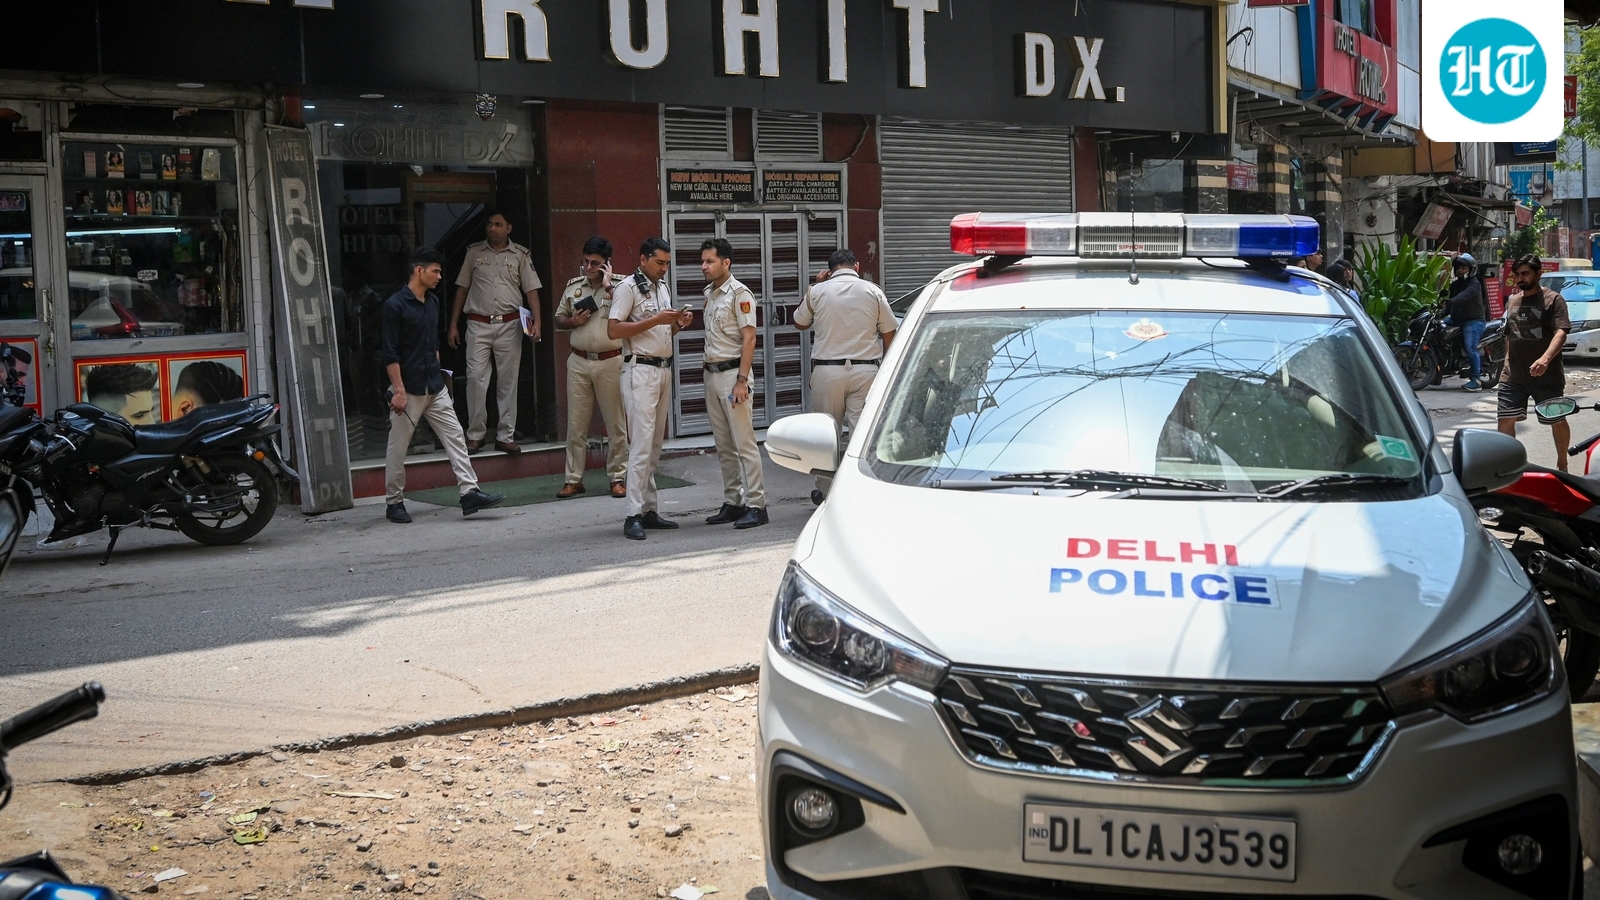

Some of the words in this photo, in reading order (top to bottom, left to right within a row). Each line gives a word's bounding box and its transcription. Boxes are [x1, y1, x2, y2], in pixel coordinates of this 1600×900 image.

[481, 0, 939, 88] ROHIT
[1335, 26, 1357, 57] HOTEL
[275, 142, 306, 161] HOTEL
[321, 123, 452, 160] ROHIT
[463, 130, 517, 163] DX
[670, 183, 682, 191] NEW
[683, 183, 693, 191] SIM
[721, 184, 752, 192] RECHARGES
[671, 172, 690, 182] NEW
[691, 173, 722, 183] MOBILE
[724, 173, 751, 183] PHONE
[765, 173, 793, 181] MOBILE
[794, 173, 819, 181] REPAIR
[820, 173, 839, 181] HERE
[341, 207, 401, 225] OTEL
[319, 481, 343, 500] DX
[1066, 537, 1239, 566] DELHI
[1049, 567, 1272, 605] POLICE
[1028, 827, 1049, 839] IND
[1049, 816, 1290, 870] DL1CAJ3539
